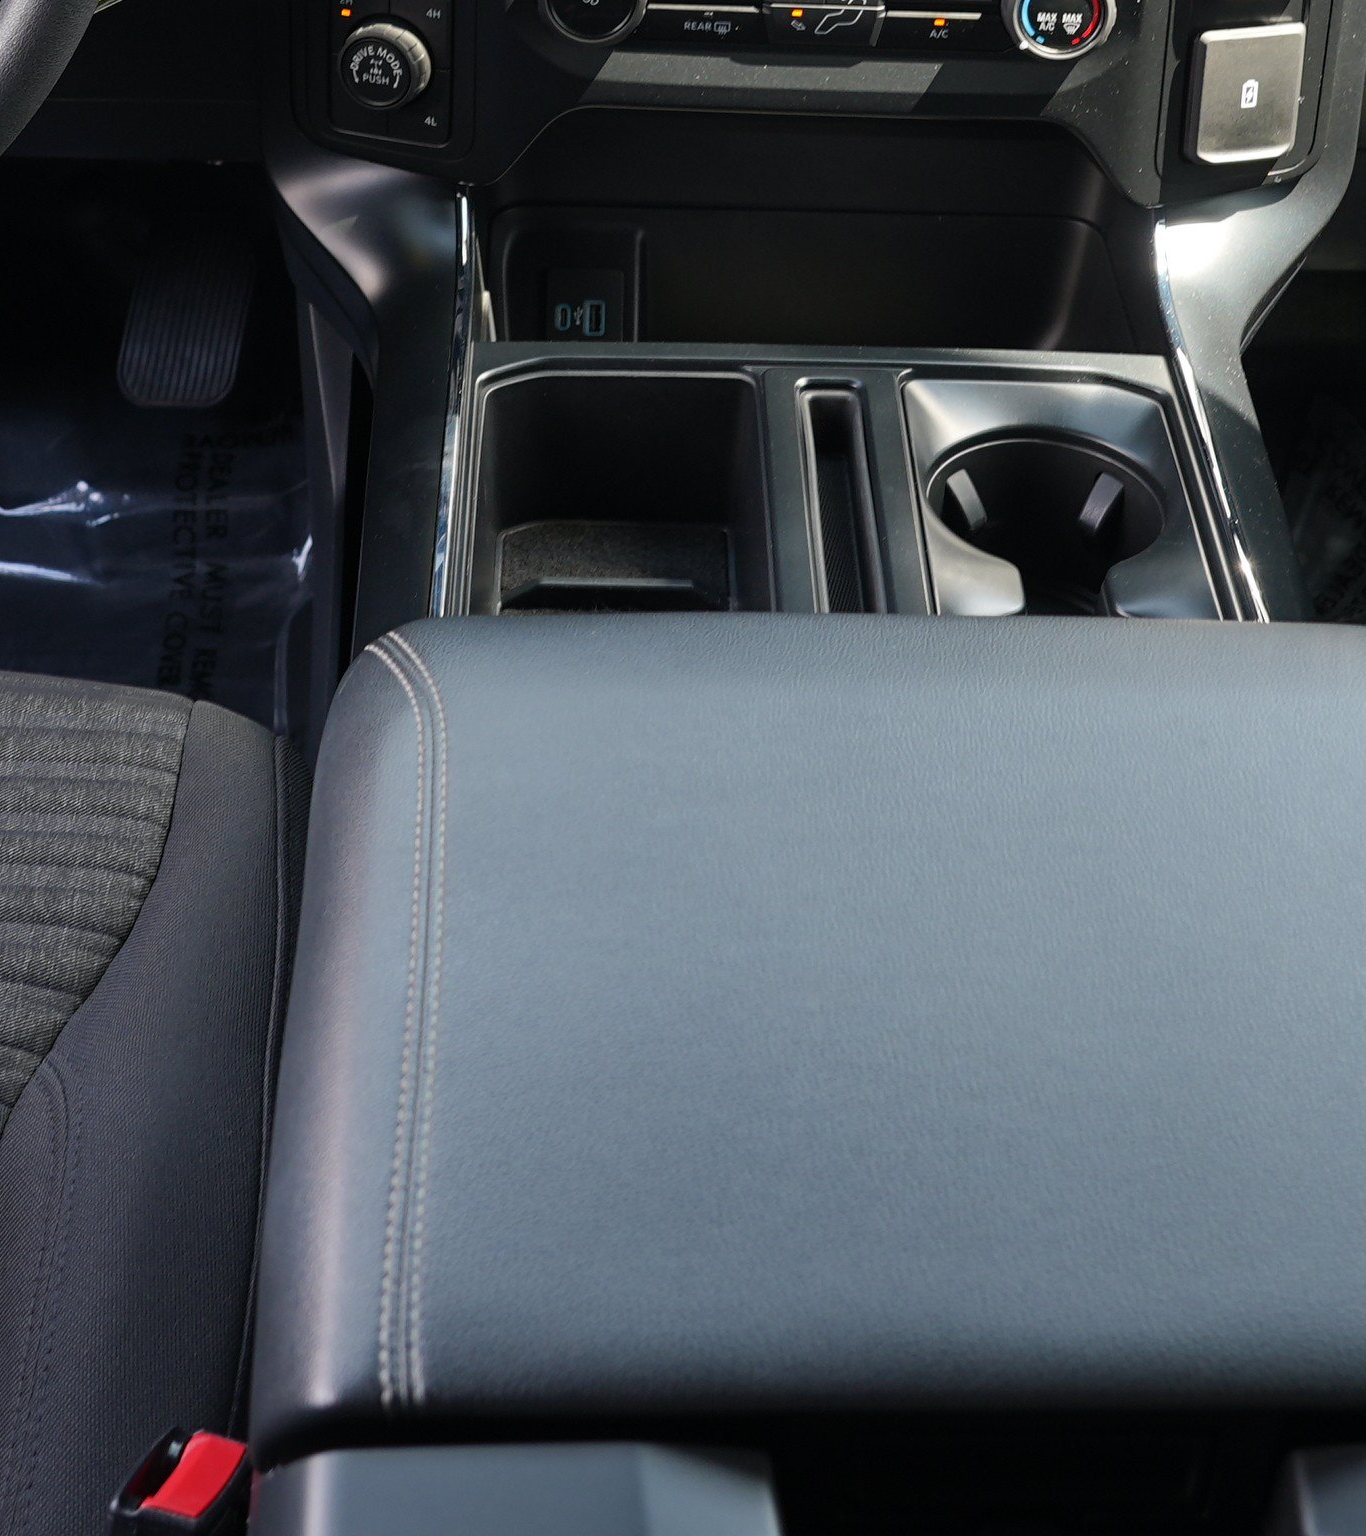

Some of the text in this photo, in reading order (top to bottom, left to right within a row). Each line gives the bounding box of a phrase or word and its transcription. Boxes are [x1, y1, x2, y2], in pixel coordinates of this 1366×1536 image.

[425, 8, 441, 20] 4H
[1037, 12, 1058, 23] MAX
[1062, 13, 1083, 24] MAX
[683, 21, 713, 31] REAR
[1039, 22, 1055, 32] A/C
[929, 29, 949, 40] A/C
[350, 45, 403, 76] DRIVE MODE
[362, 73, 390, 85] PUSH
[424, 115, 438, 127] 4L
